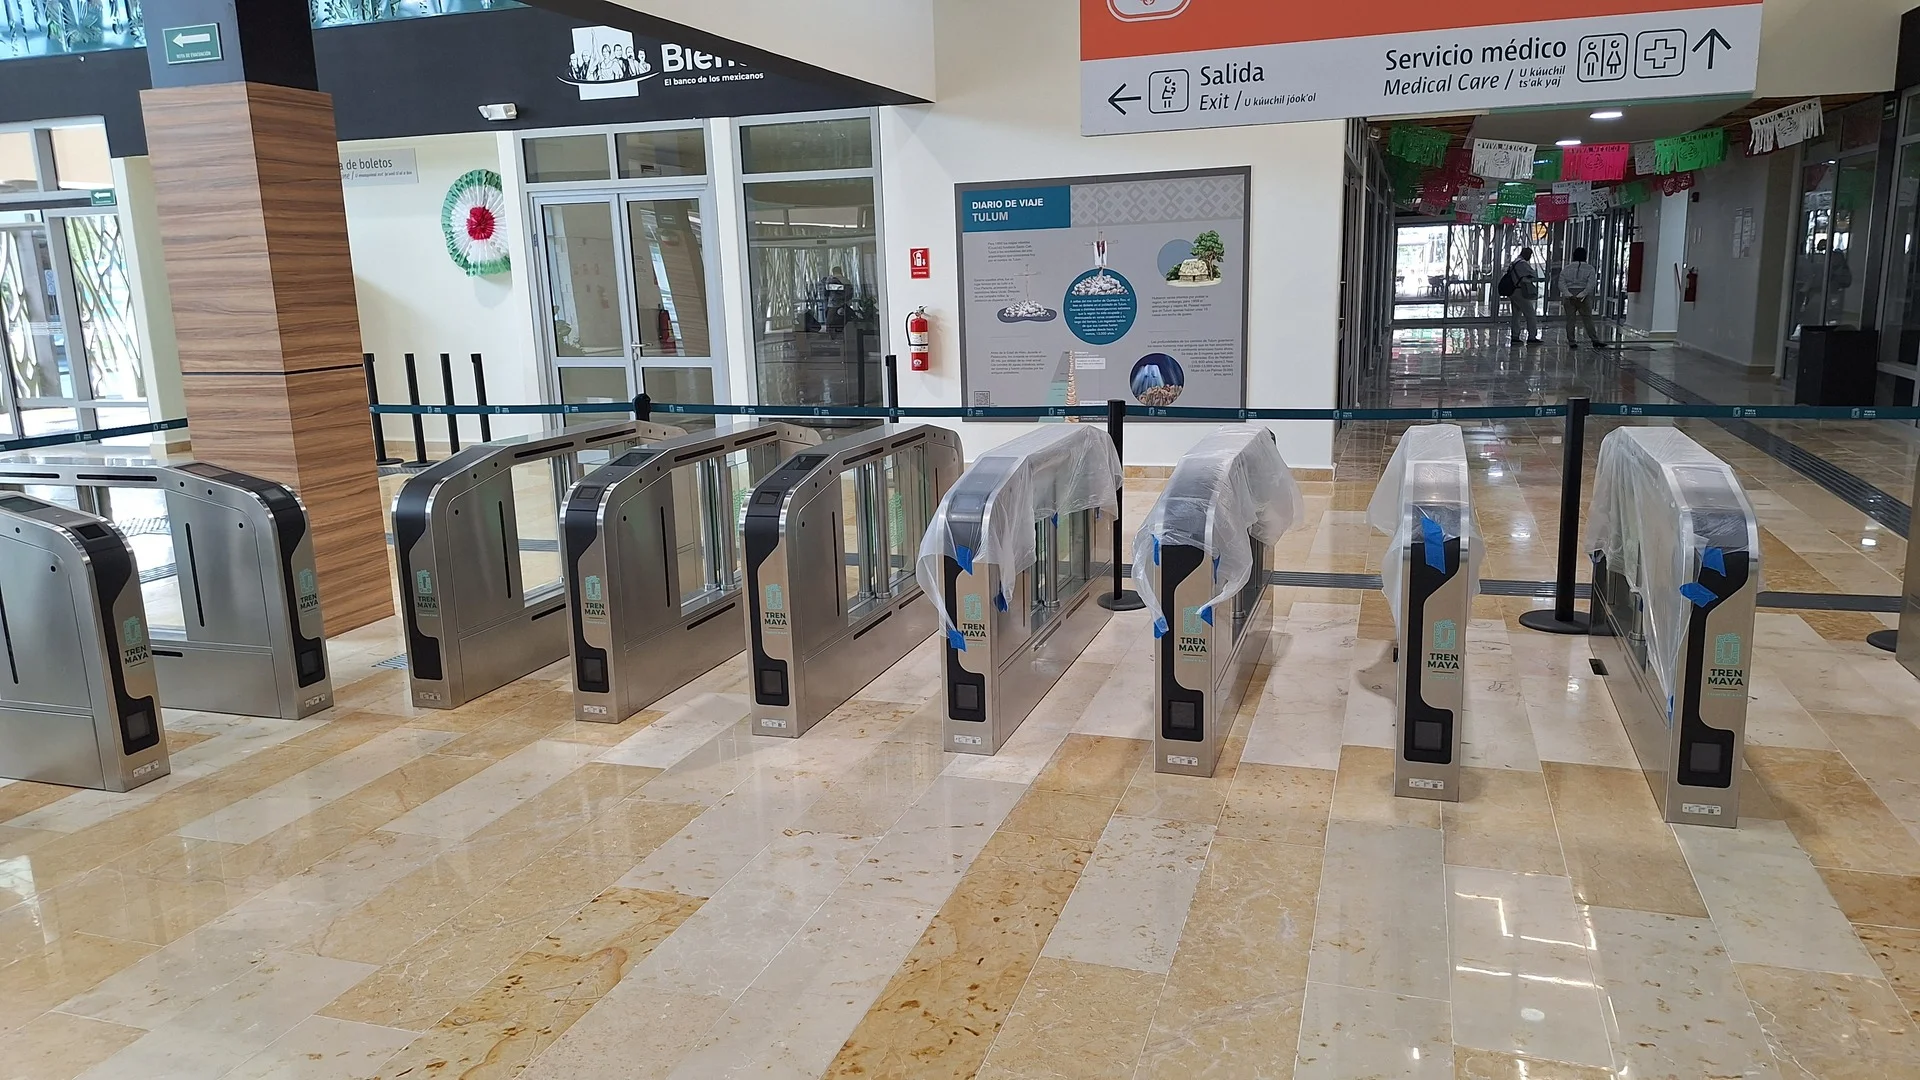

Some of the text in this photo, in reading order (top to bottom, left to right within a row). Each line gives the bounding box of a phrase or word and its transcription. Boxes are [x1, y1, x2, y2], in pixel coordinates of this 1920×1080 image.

[1386, 37, 1566, 70] Servicio médico
[1200, 61, 1265, 86] Salida
[1519, 65, 1566, 78] U kúuchil
[673, 77, 696, 85] banco
[722, 72, 764, 82] mexicanos
[1544, 77, 1562, 88] yaj
[1384, 74, 1452, 97] Medical
[1458, 74, 1500, 91] Care
[1199, 93, 1230, 110] Exit
[1244, 98, 1252, 106] U
[1253, 94, 1285, 106] kúuchil
[346, 159, 357, 170] de
[359, 158, 392, 170] boletos
[972, 200, 1002, 209] DIARIO
[1019, 198, 1044, 207] VIAJE
[972, 212, 1008, 222] TULUM
[300, 593, 318, 603] TREN
[300, 600, 318, 610] MAYA
[584, 608, 606, 616] MAYA
[962, 629, 987, 638] MAYA
[1180, 637, 1206, 645] TREN
[124, 645, 147, 657] TREN
[1178, 644, 1207, 653] MAYA
[124, 652, 149, 664] MAYA
[1429, 653, 1458, 662] TREN
[1427, 660, 1460, 670] MAYA
[1710, 668, 1743, 677] TREN
[1708, 676, 1744, 686] MAYA
